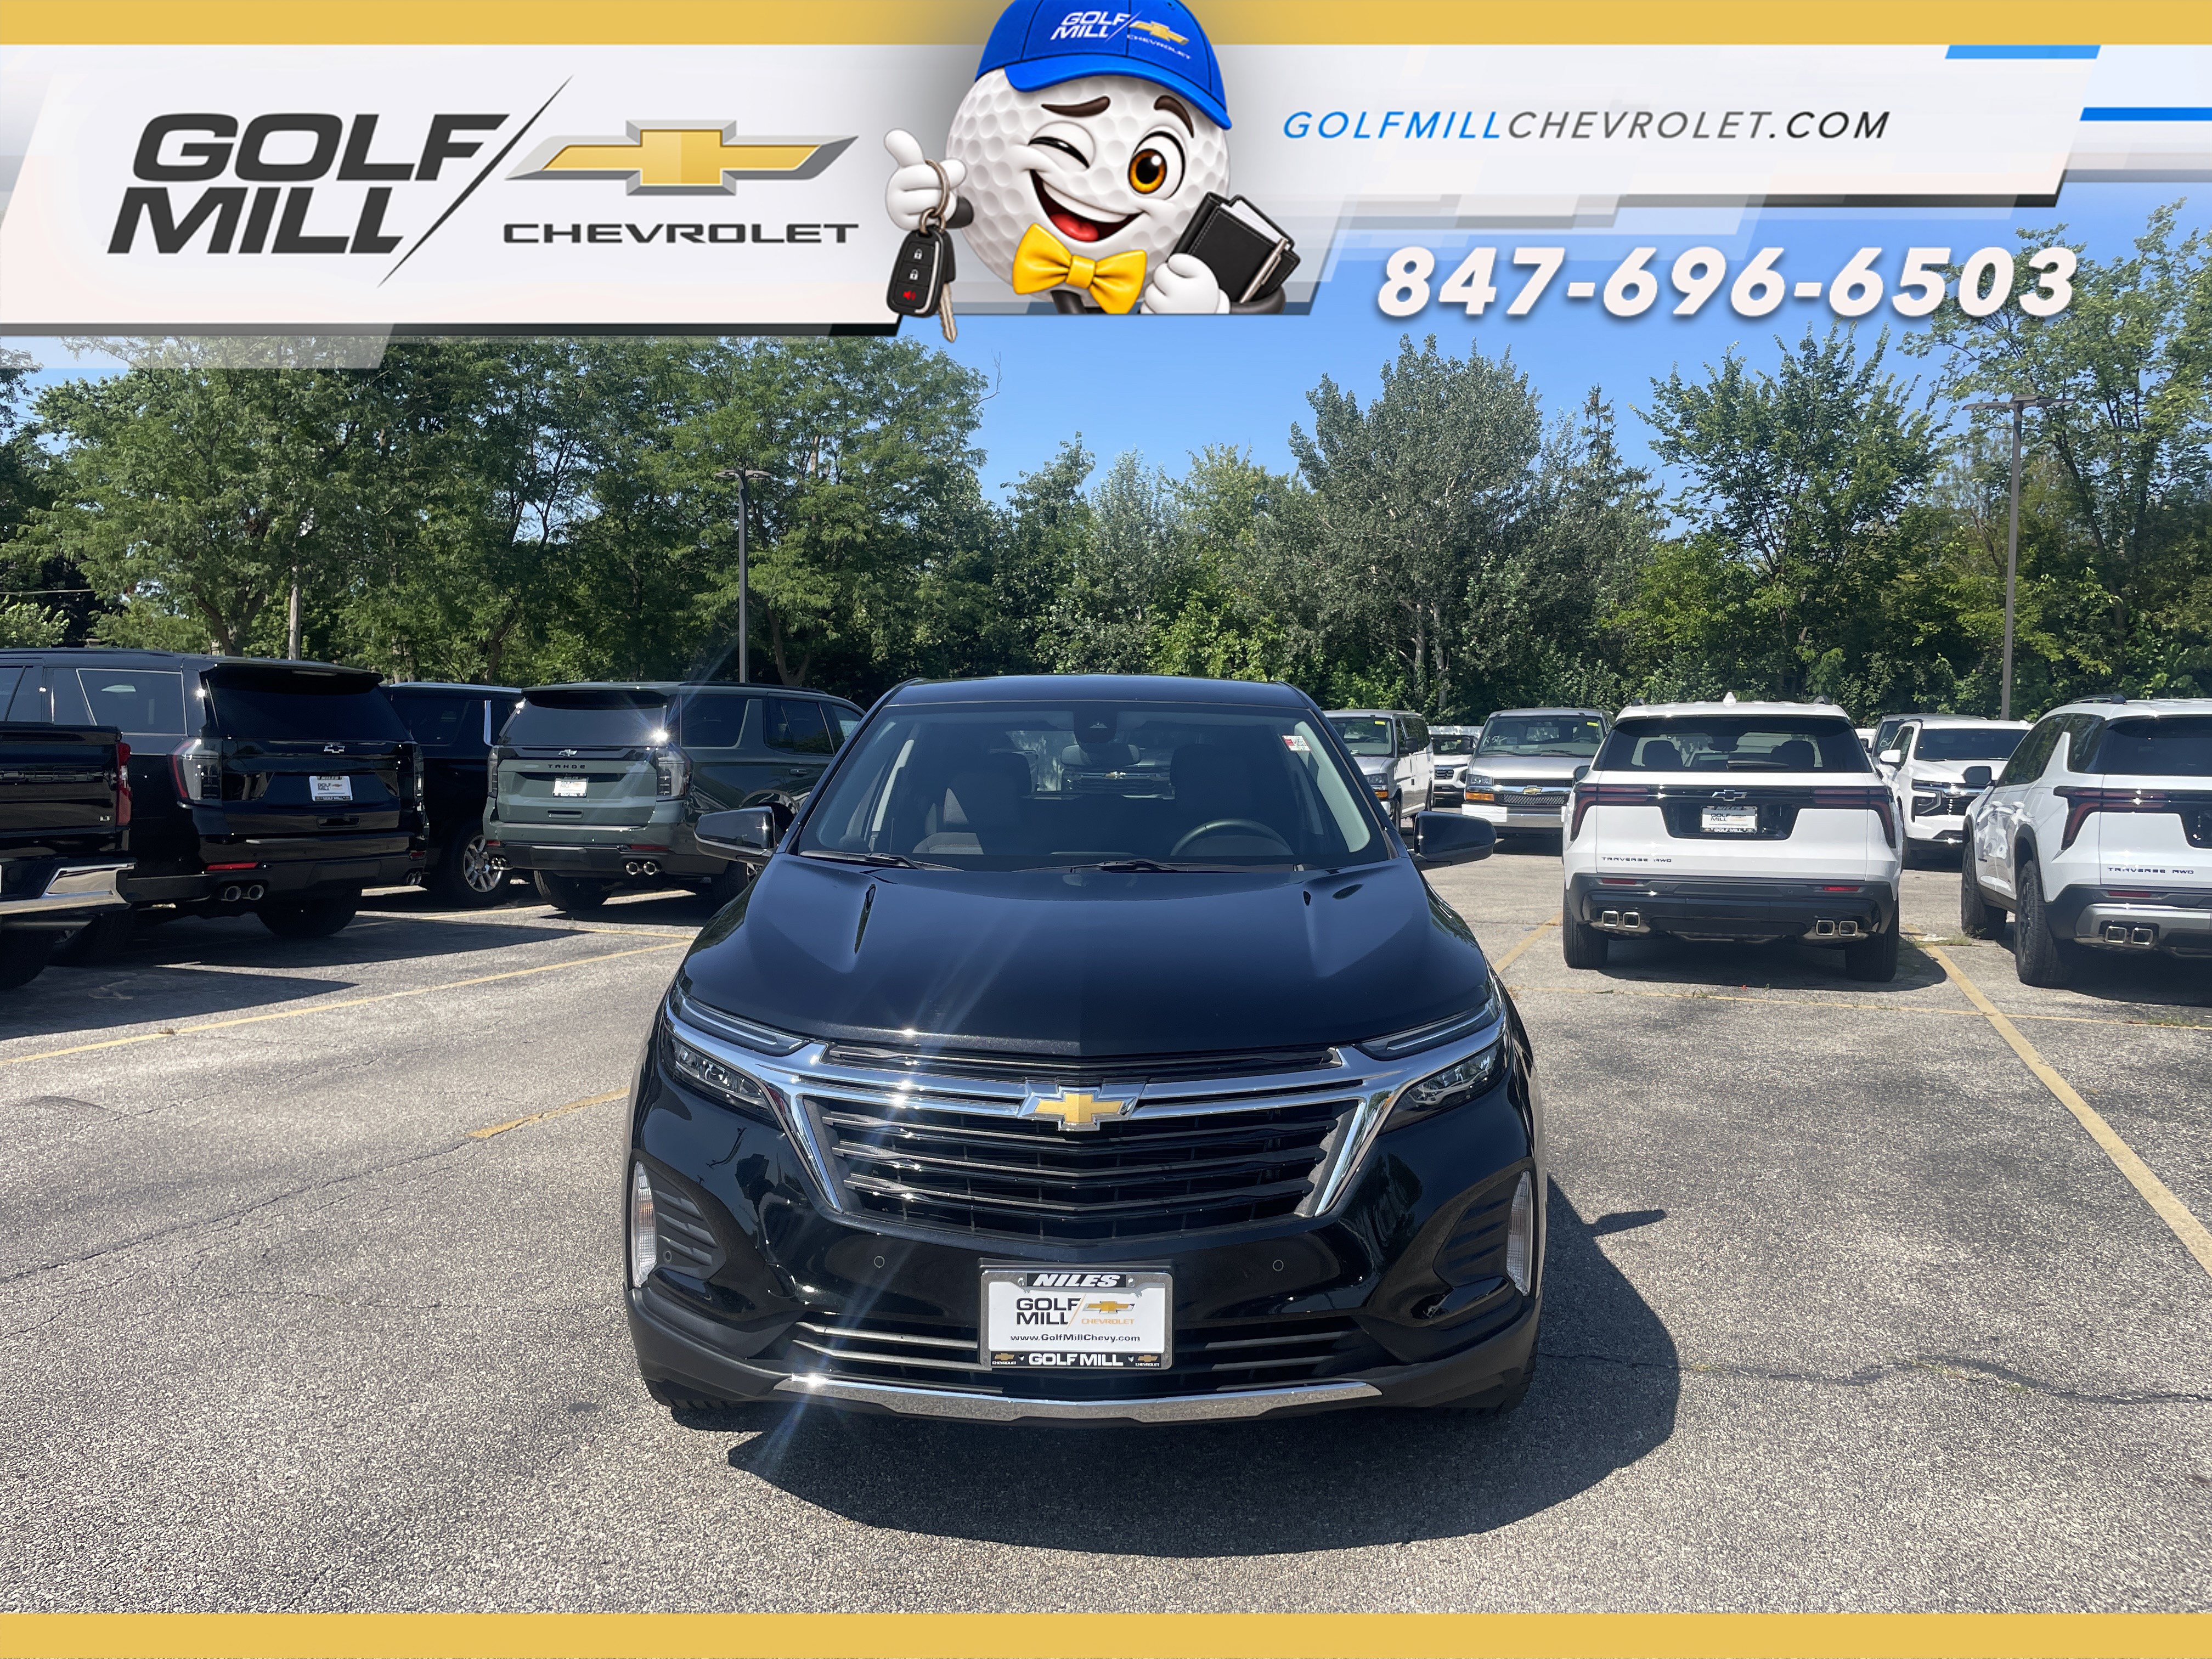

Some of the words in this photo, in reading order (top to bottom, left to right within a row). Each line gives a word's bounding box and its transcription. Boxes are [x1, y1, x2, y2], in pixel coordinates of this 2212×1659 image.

[1032, 1274, 1120, 1287] NILES
[1016, 1297, 1081, 1311] GOLF
[1016, 1312, 1069, 1325] MILL
[1010, 1334, 1141, 1342] www.GolfMillChevy.com
[1029, 1353, 1077, 1365] GOLF
[1080, 1353, 1124, 1366] MILL
